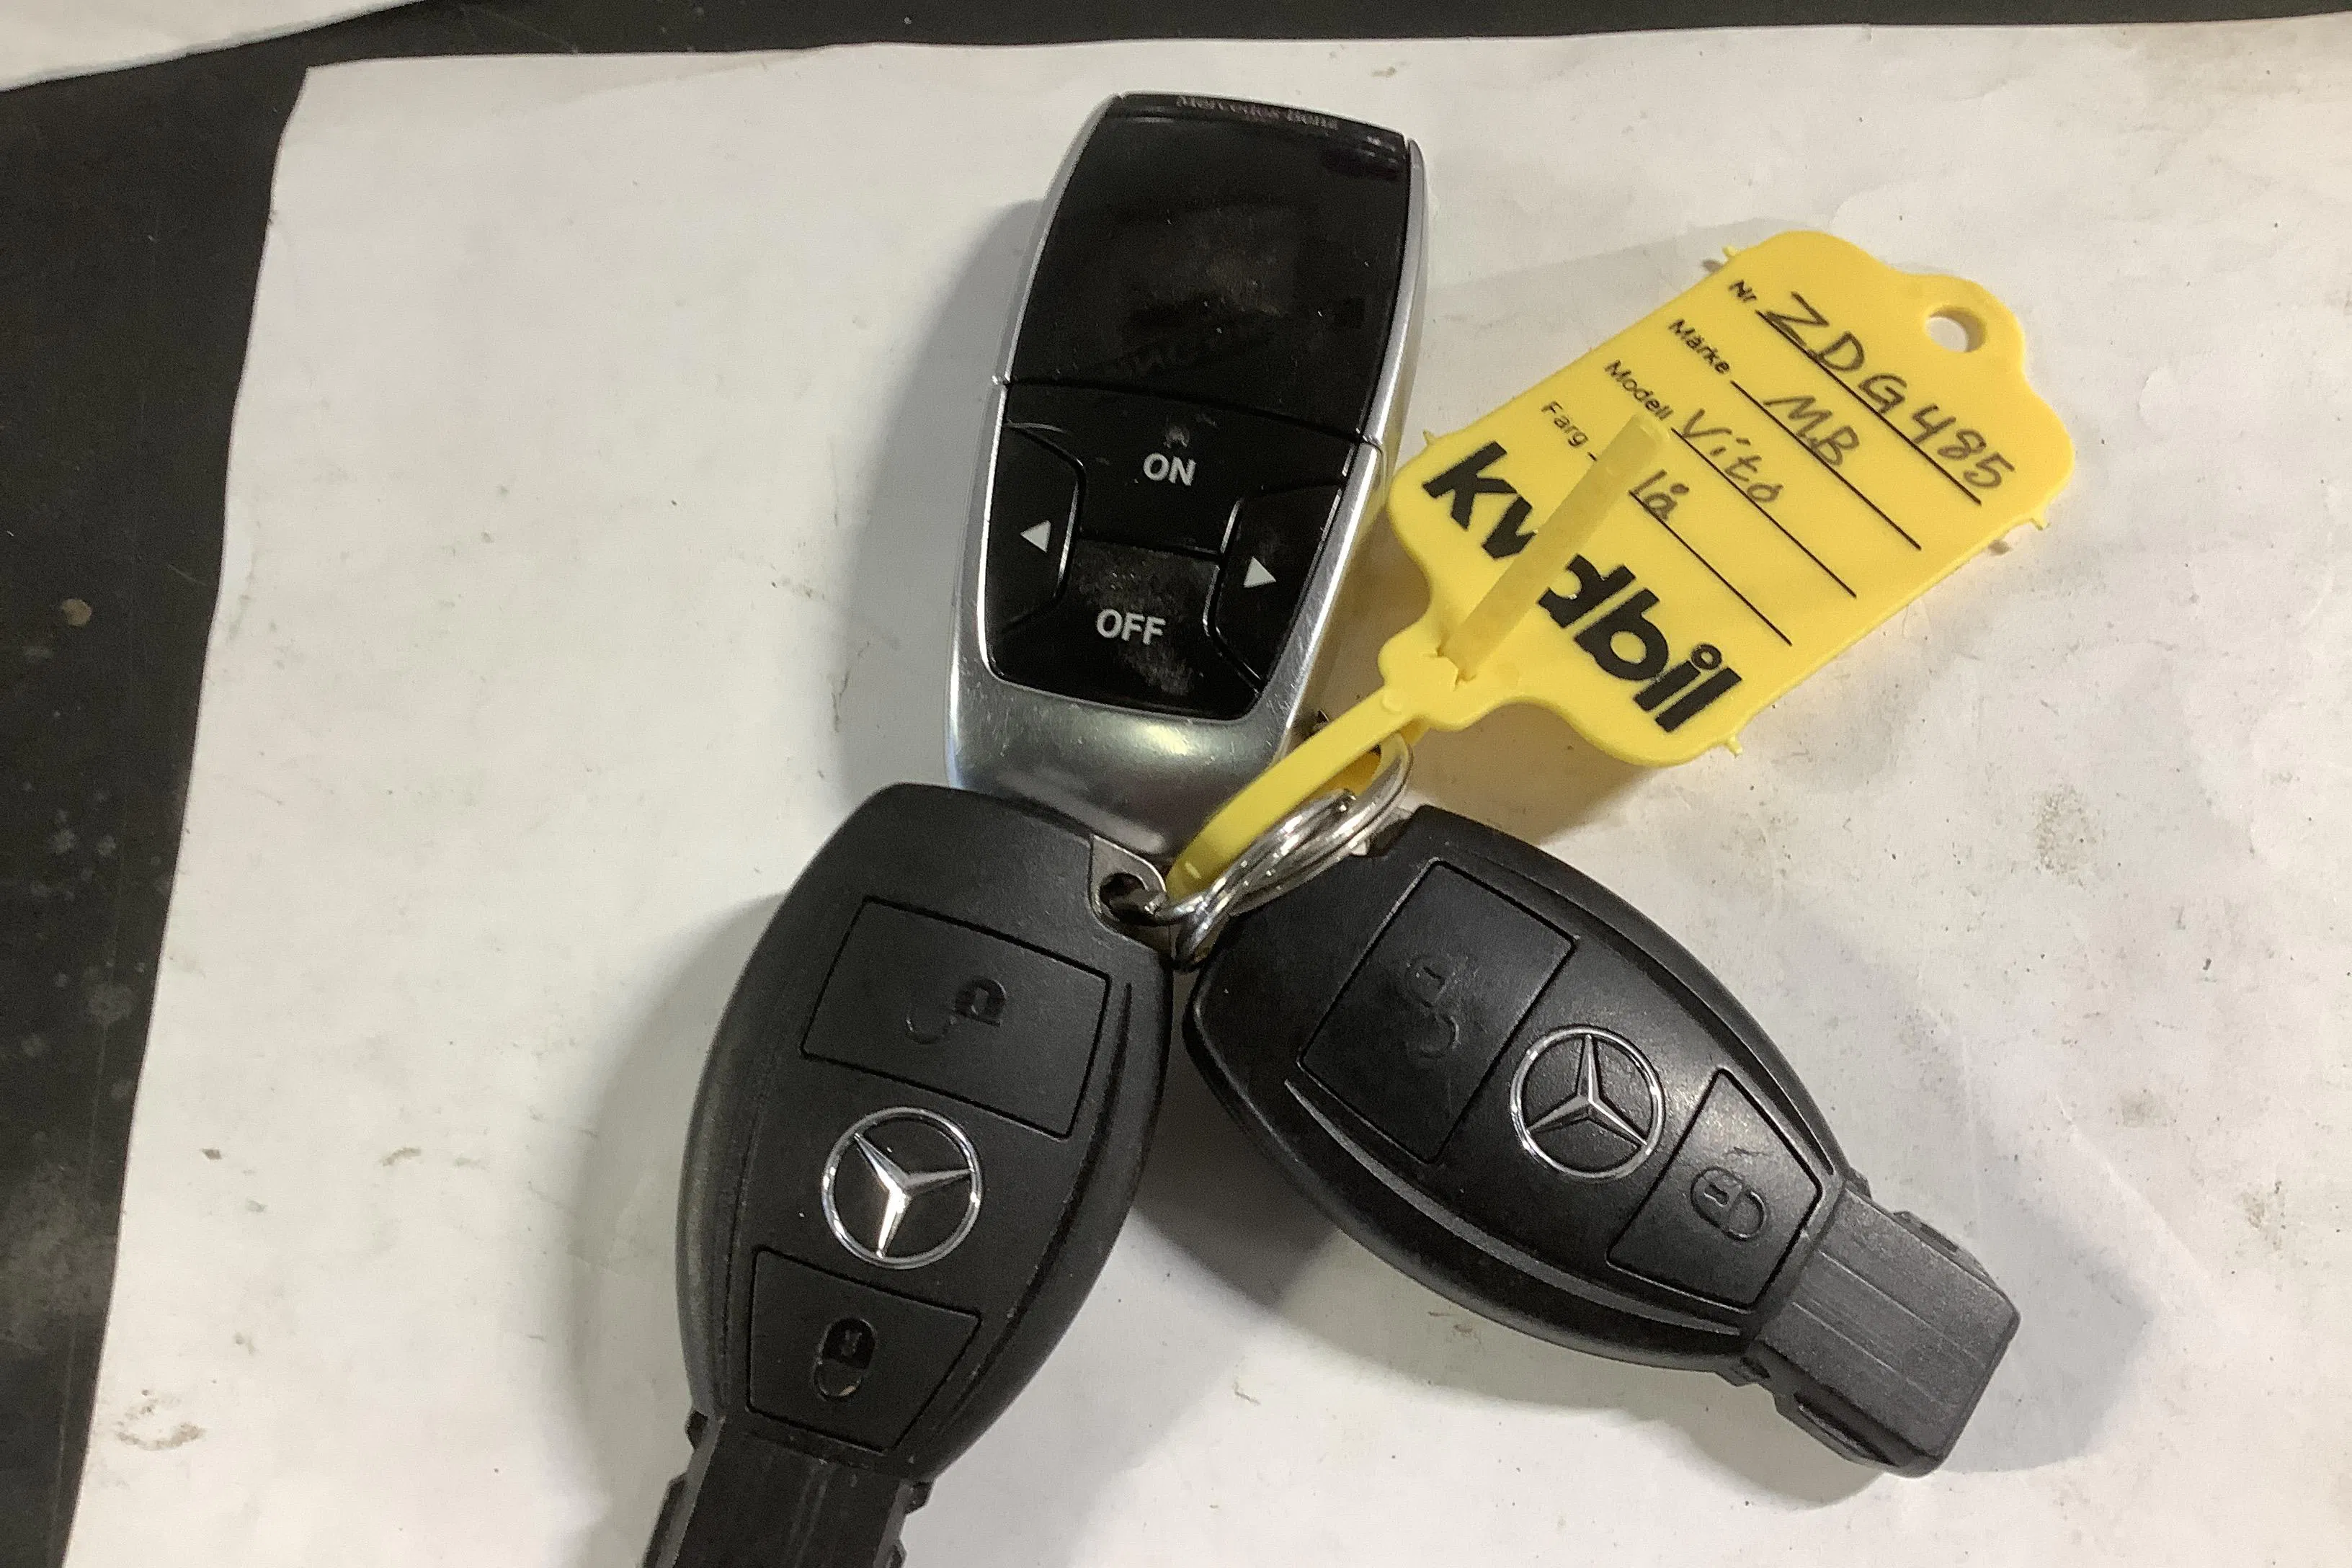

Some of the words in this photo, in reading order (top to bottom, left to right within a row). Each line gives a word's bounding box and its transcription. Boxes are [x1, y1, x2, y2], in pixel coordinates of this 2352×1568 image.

[1729, 280, 1757, 303] Nr
[1603, 359, 1674, 421] Modell
[1764, 290, 2015, 489] ZDG485
[1763, 395, 1861, 466] MB
[1143, 453, 1197, 486] ON
[1631, 469, 1690, 522] lå
[1096, 608, 1167, 645] OFF
